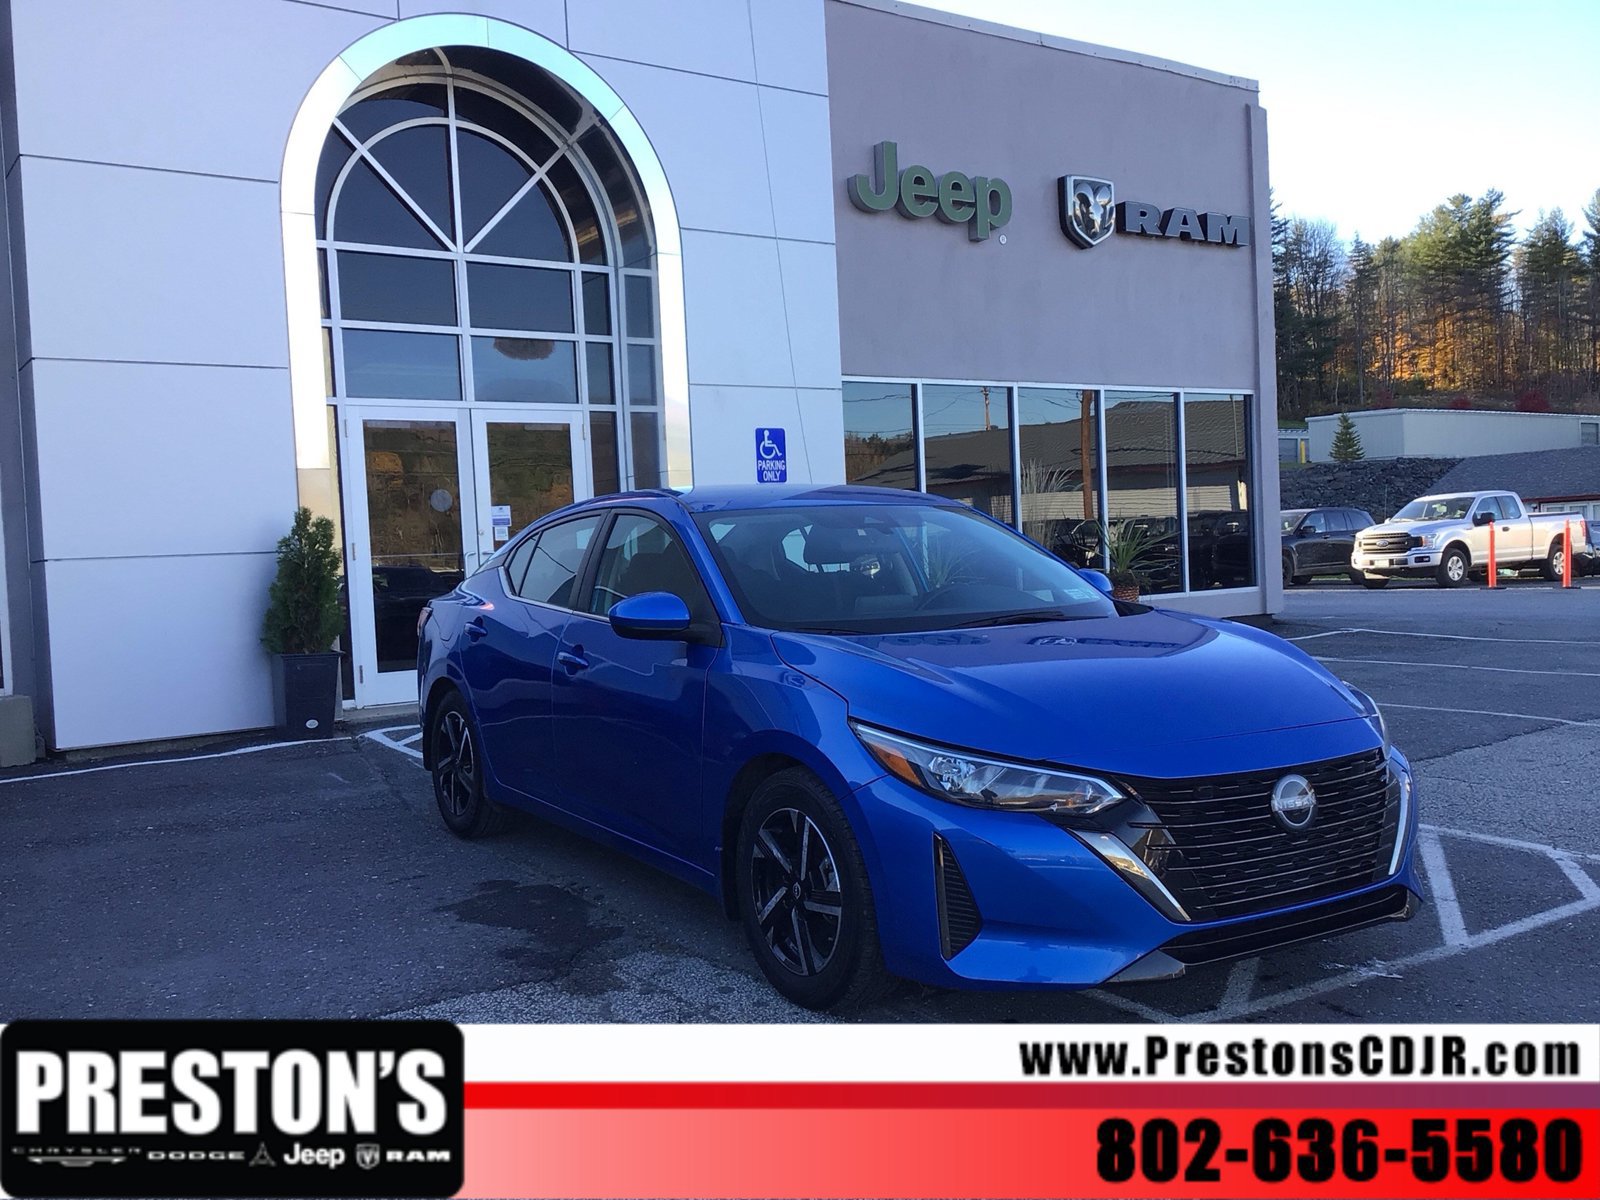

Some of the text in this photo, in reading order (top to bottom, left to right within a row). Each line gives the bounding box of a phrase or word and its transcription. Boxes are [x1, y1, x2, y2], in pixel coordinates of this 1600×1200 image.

[848, 140, 1012, 242] Jeep
[1118, 201, 1251, 247] RAM
[757, 460, 786, 470] PARKING
[763, 470, 781, 481] ONLY
